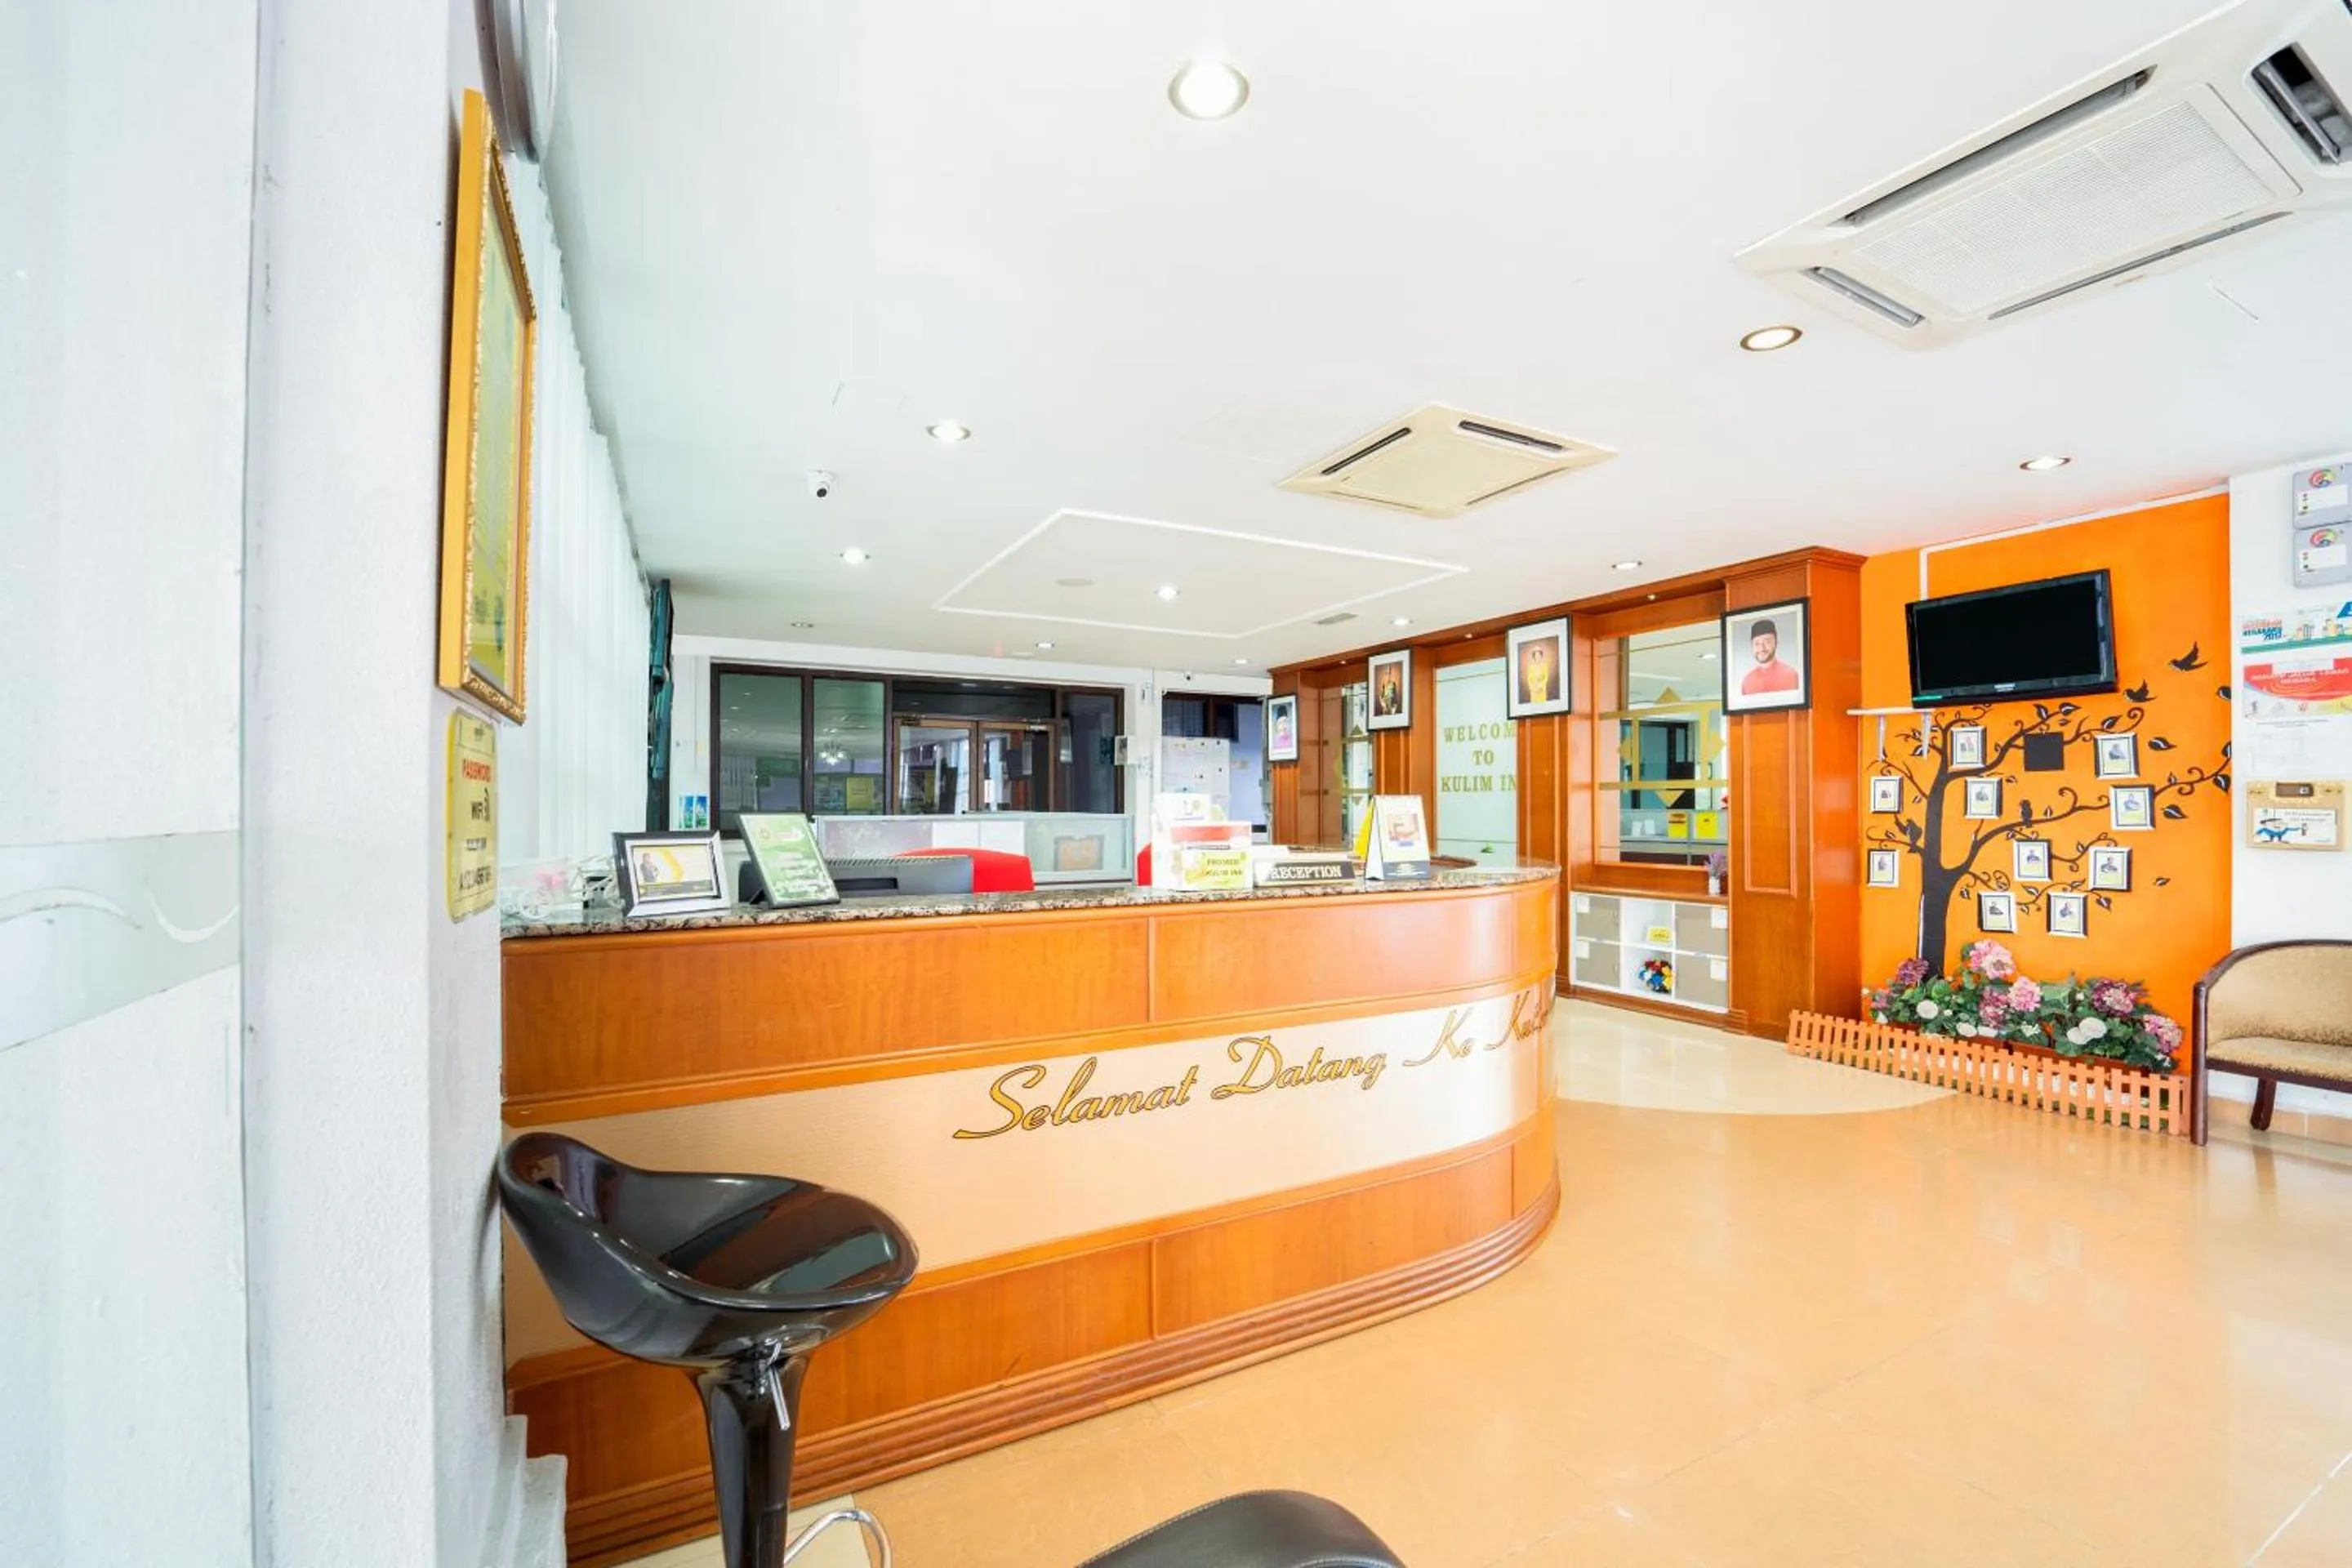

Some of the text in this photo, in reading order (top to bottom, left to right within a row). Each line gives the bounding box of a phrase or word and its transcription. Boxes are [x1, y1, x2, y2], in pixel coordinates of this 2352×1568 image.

[1472, 749, 1494, 765] TO
[1441, 775, 1493, 791] KULIM
[1268, 866, 1343, 880] RECEPTION
[952, 1056, 1199, 1138] Selamat
[1210, 1036, 1387, 1099] Datang
